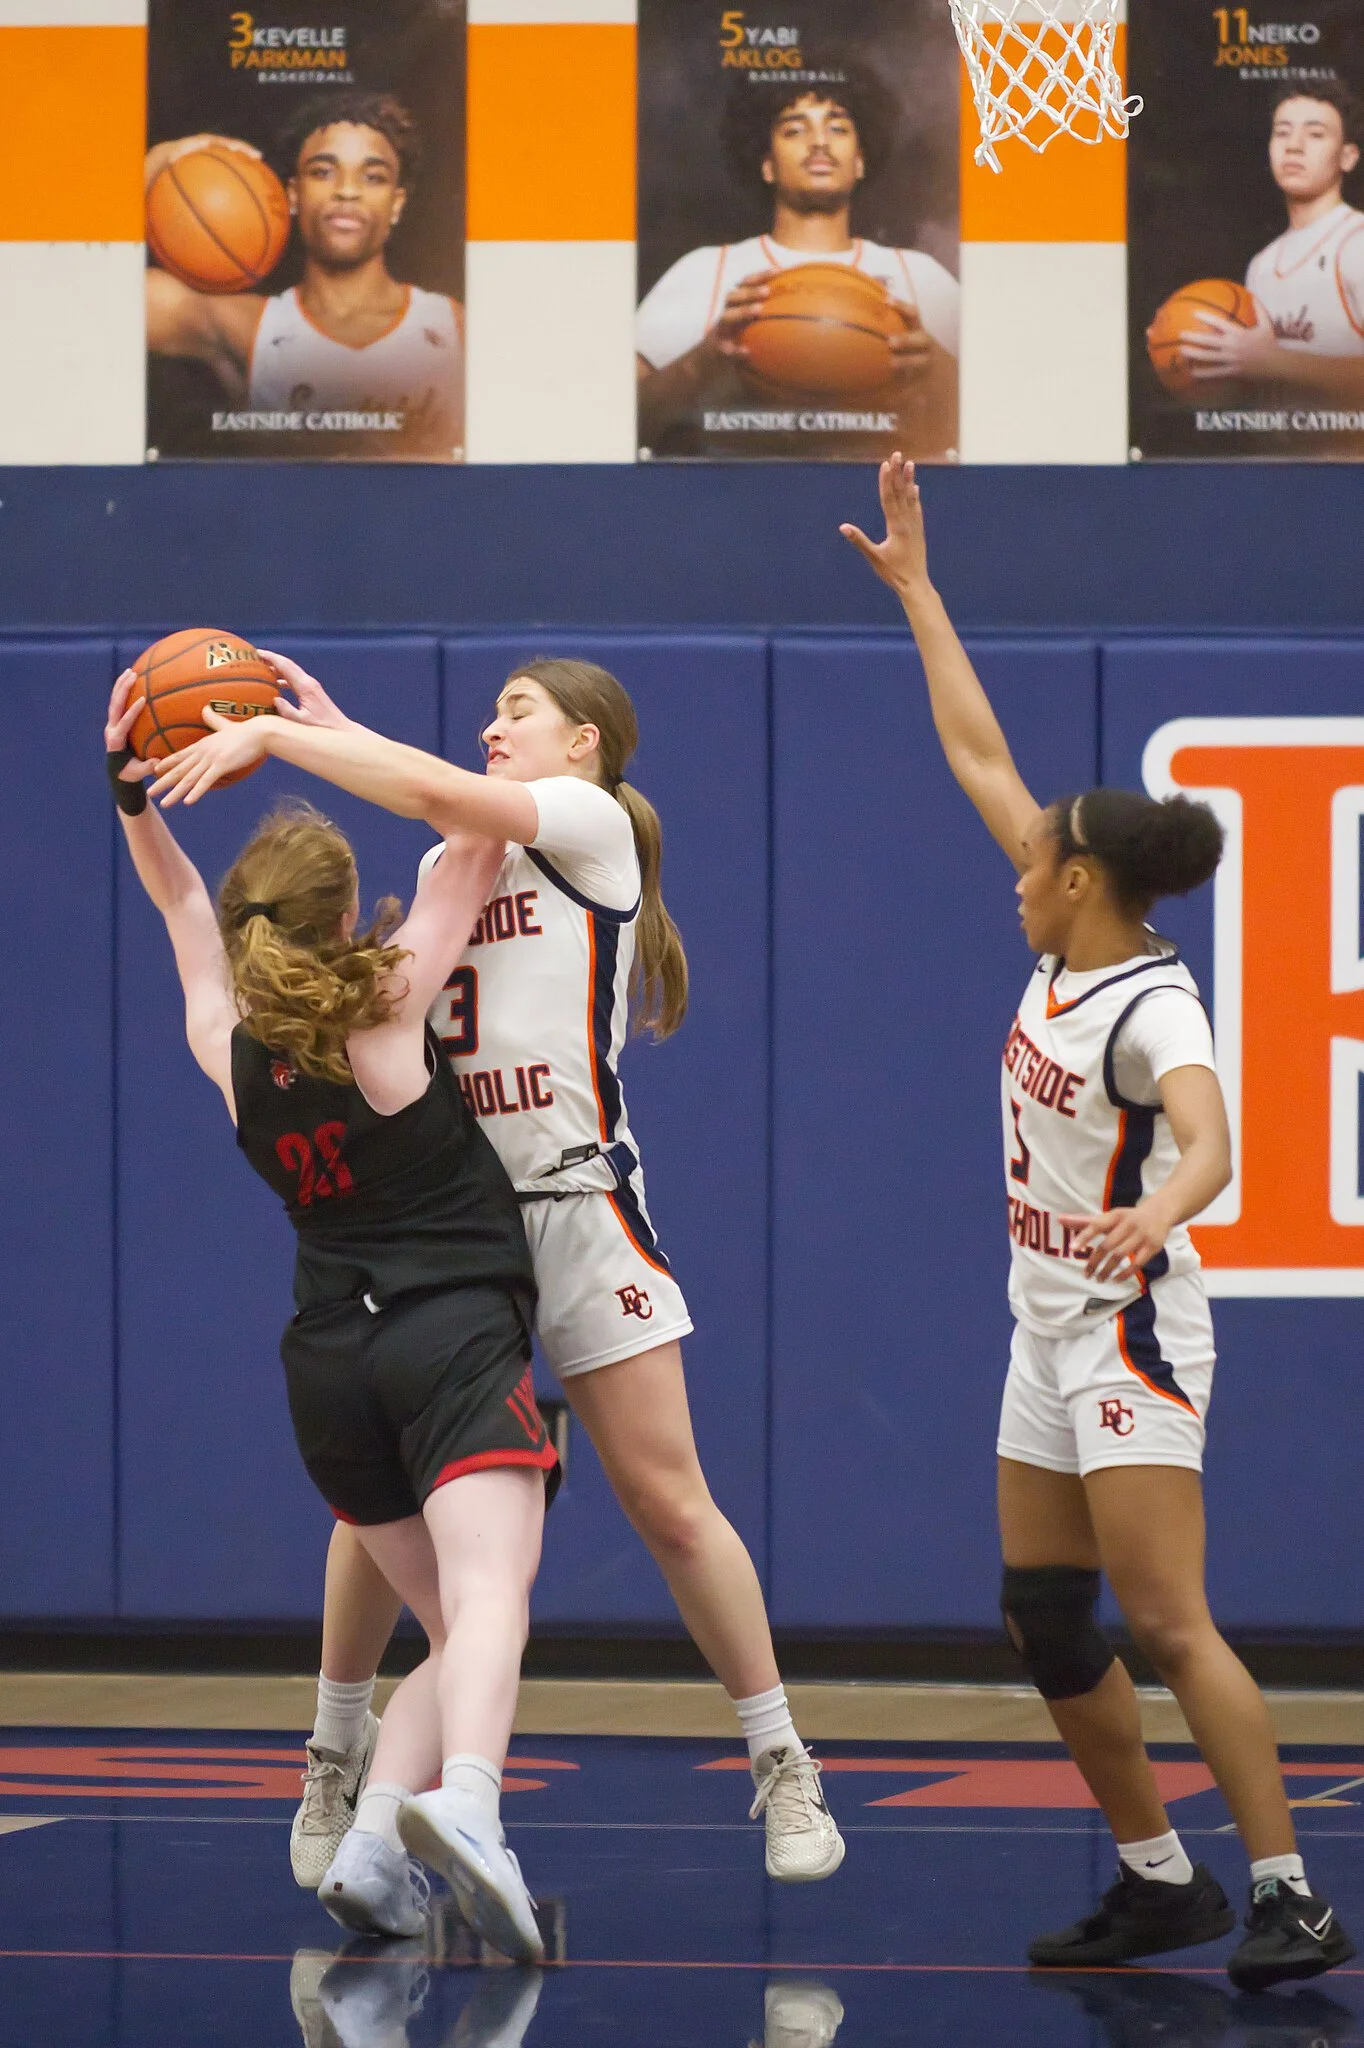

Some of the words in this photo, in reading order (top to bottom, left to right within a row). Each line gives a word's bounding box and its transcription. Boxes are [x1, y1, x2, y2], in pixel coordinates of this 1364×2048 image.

[228, 12, 254, 48] 3
[253, 27, 346, 47] KEVELLE
[719, 10, 745, 47] 5
[745, 27, 798, 46] YABI
[1212, 7, 1249, 44] 11
[1247, 23, 1320, 44] NEIKO
[230, 50, 347, 68] PARKMAN
[721, 49, 802, 68] AKLOG
[1213, 46, 1289, 66] JONES
[258, 71, 353, 83] BASKETBALL
[750, 70, 846, 82] BASKETBALL
[1239, 67, 1337, 80] BASKETBALL
[212, 412, 301, 430] EASTSIDE
[306, 412, 402, 430] CATHOLIC
[704, 412, 796, 430] EASTSIDE
[799, 412, 897, 430] CATHOLIC
[1196, 411, 1287, 430] EASTSIDE
